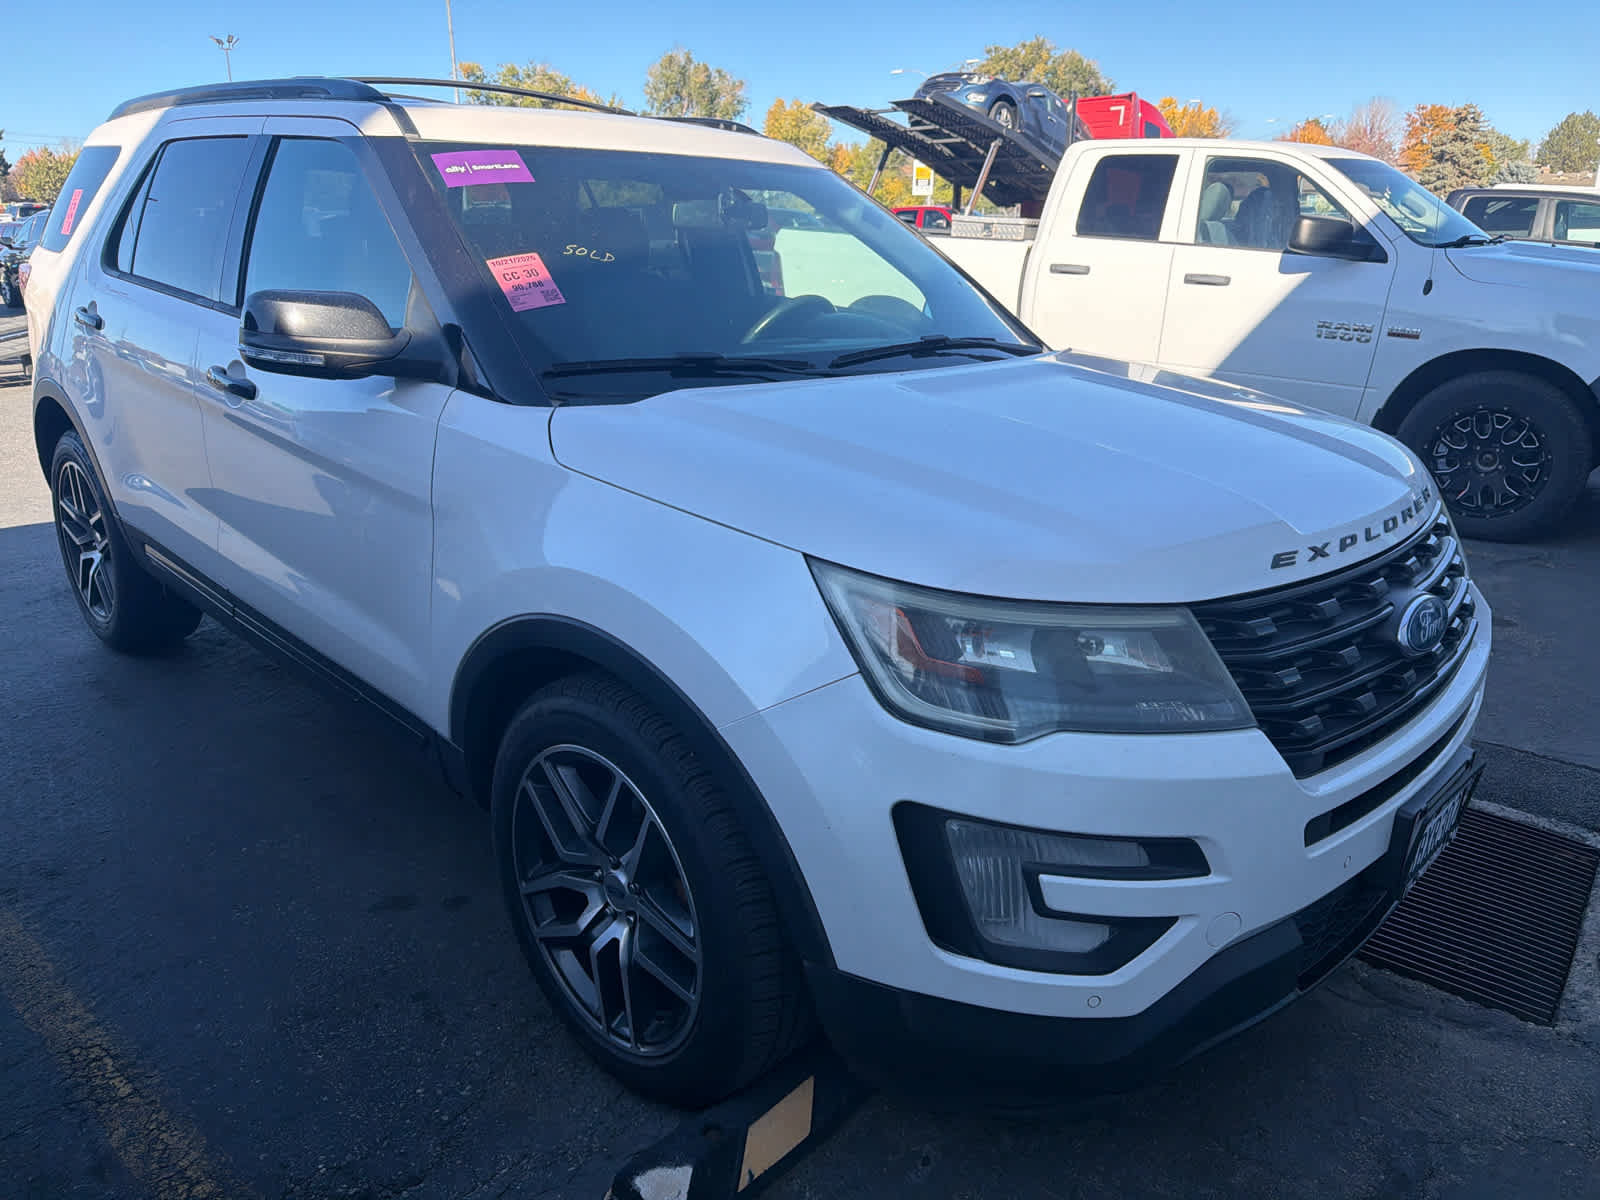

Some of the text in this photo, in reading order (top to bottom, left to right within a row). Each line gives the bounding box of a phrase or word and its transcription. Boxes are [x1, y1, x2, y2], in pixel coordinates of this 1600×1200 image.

[1109, 105, 1125, 126] 7
[445, 165, 466, 174] ally
[563, 244, 615, 262] SOLD
[502, 267, 540, 282] CC 30
[1316, 320, 1374, 333] RAM
[1316, 328, 1373, 344] 1500
[1270, 487, 1432, 570] EXPLORER
